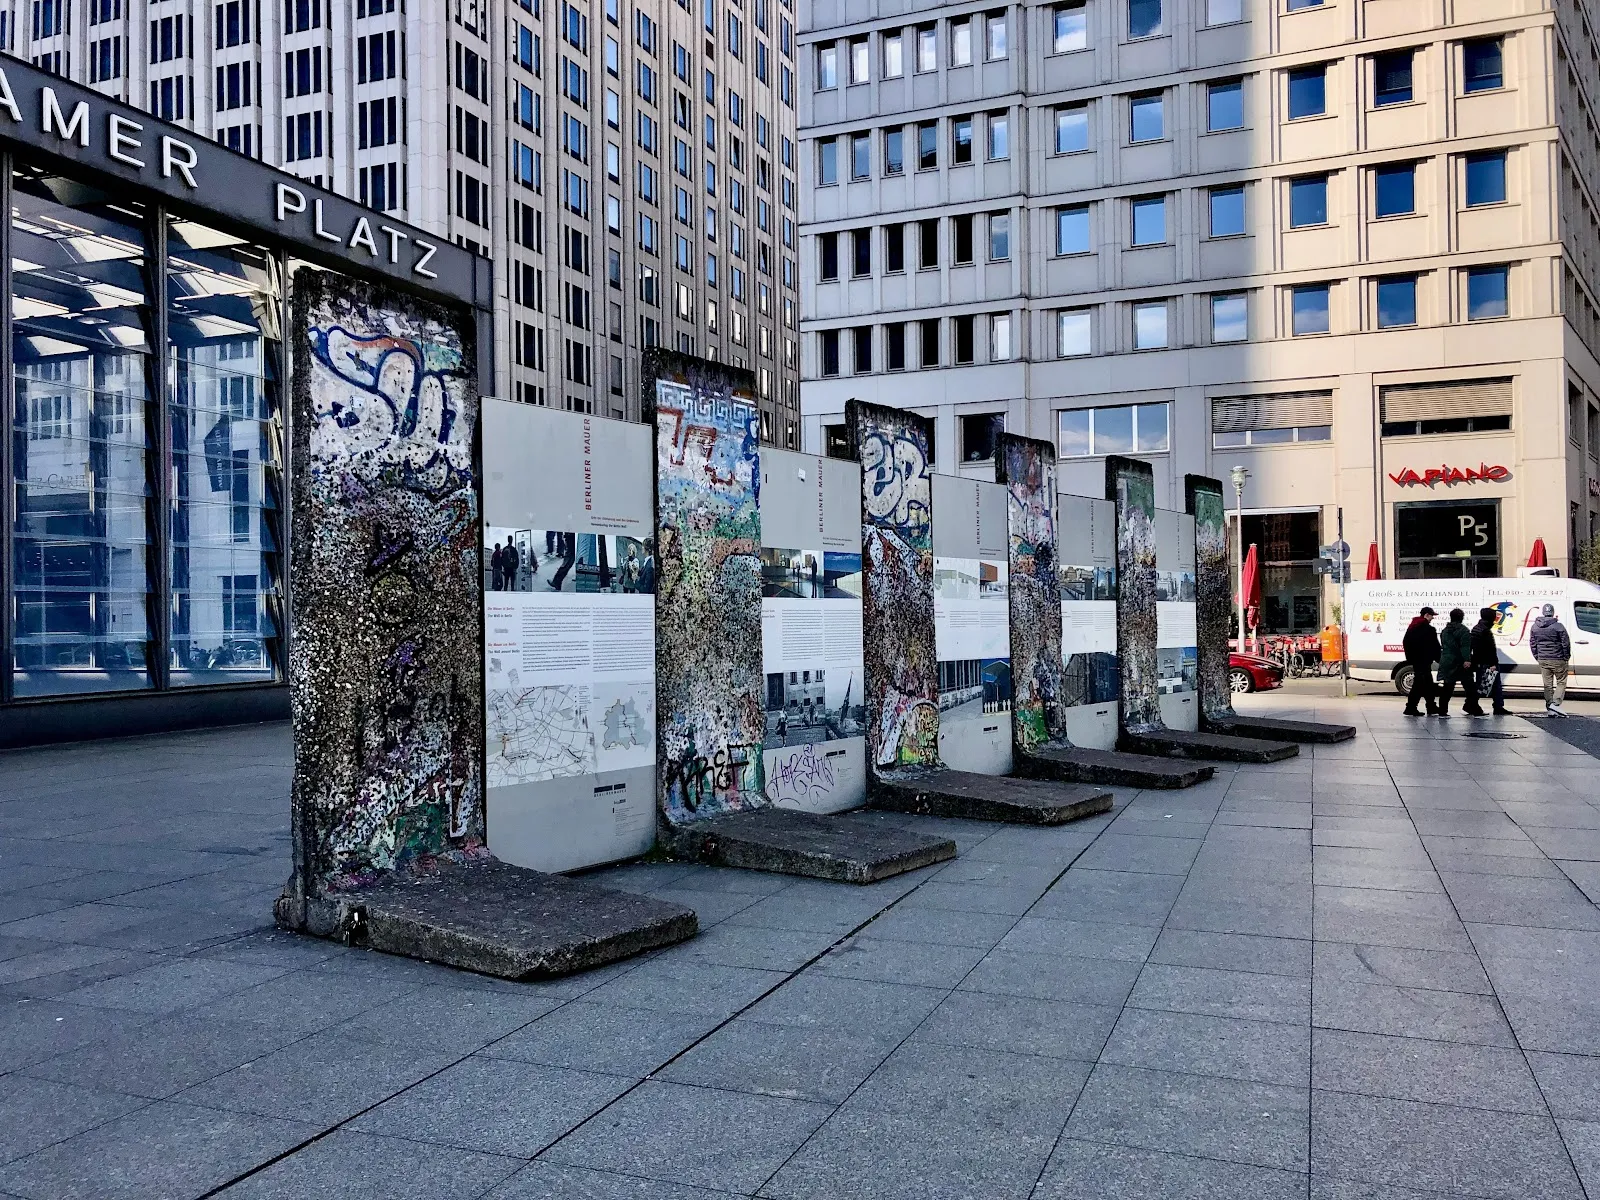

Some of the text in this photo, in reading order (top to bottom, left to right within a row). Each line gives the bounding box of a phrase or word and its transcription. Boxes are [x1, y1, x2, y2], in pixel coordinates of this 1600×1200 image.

[277, 183, 438, 279] PLATZ
[583, 418, 592, 511] BERLINER MAUER
[1388, 462, 1508, 488] VAPIANO
